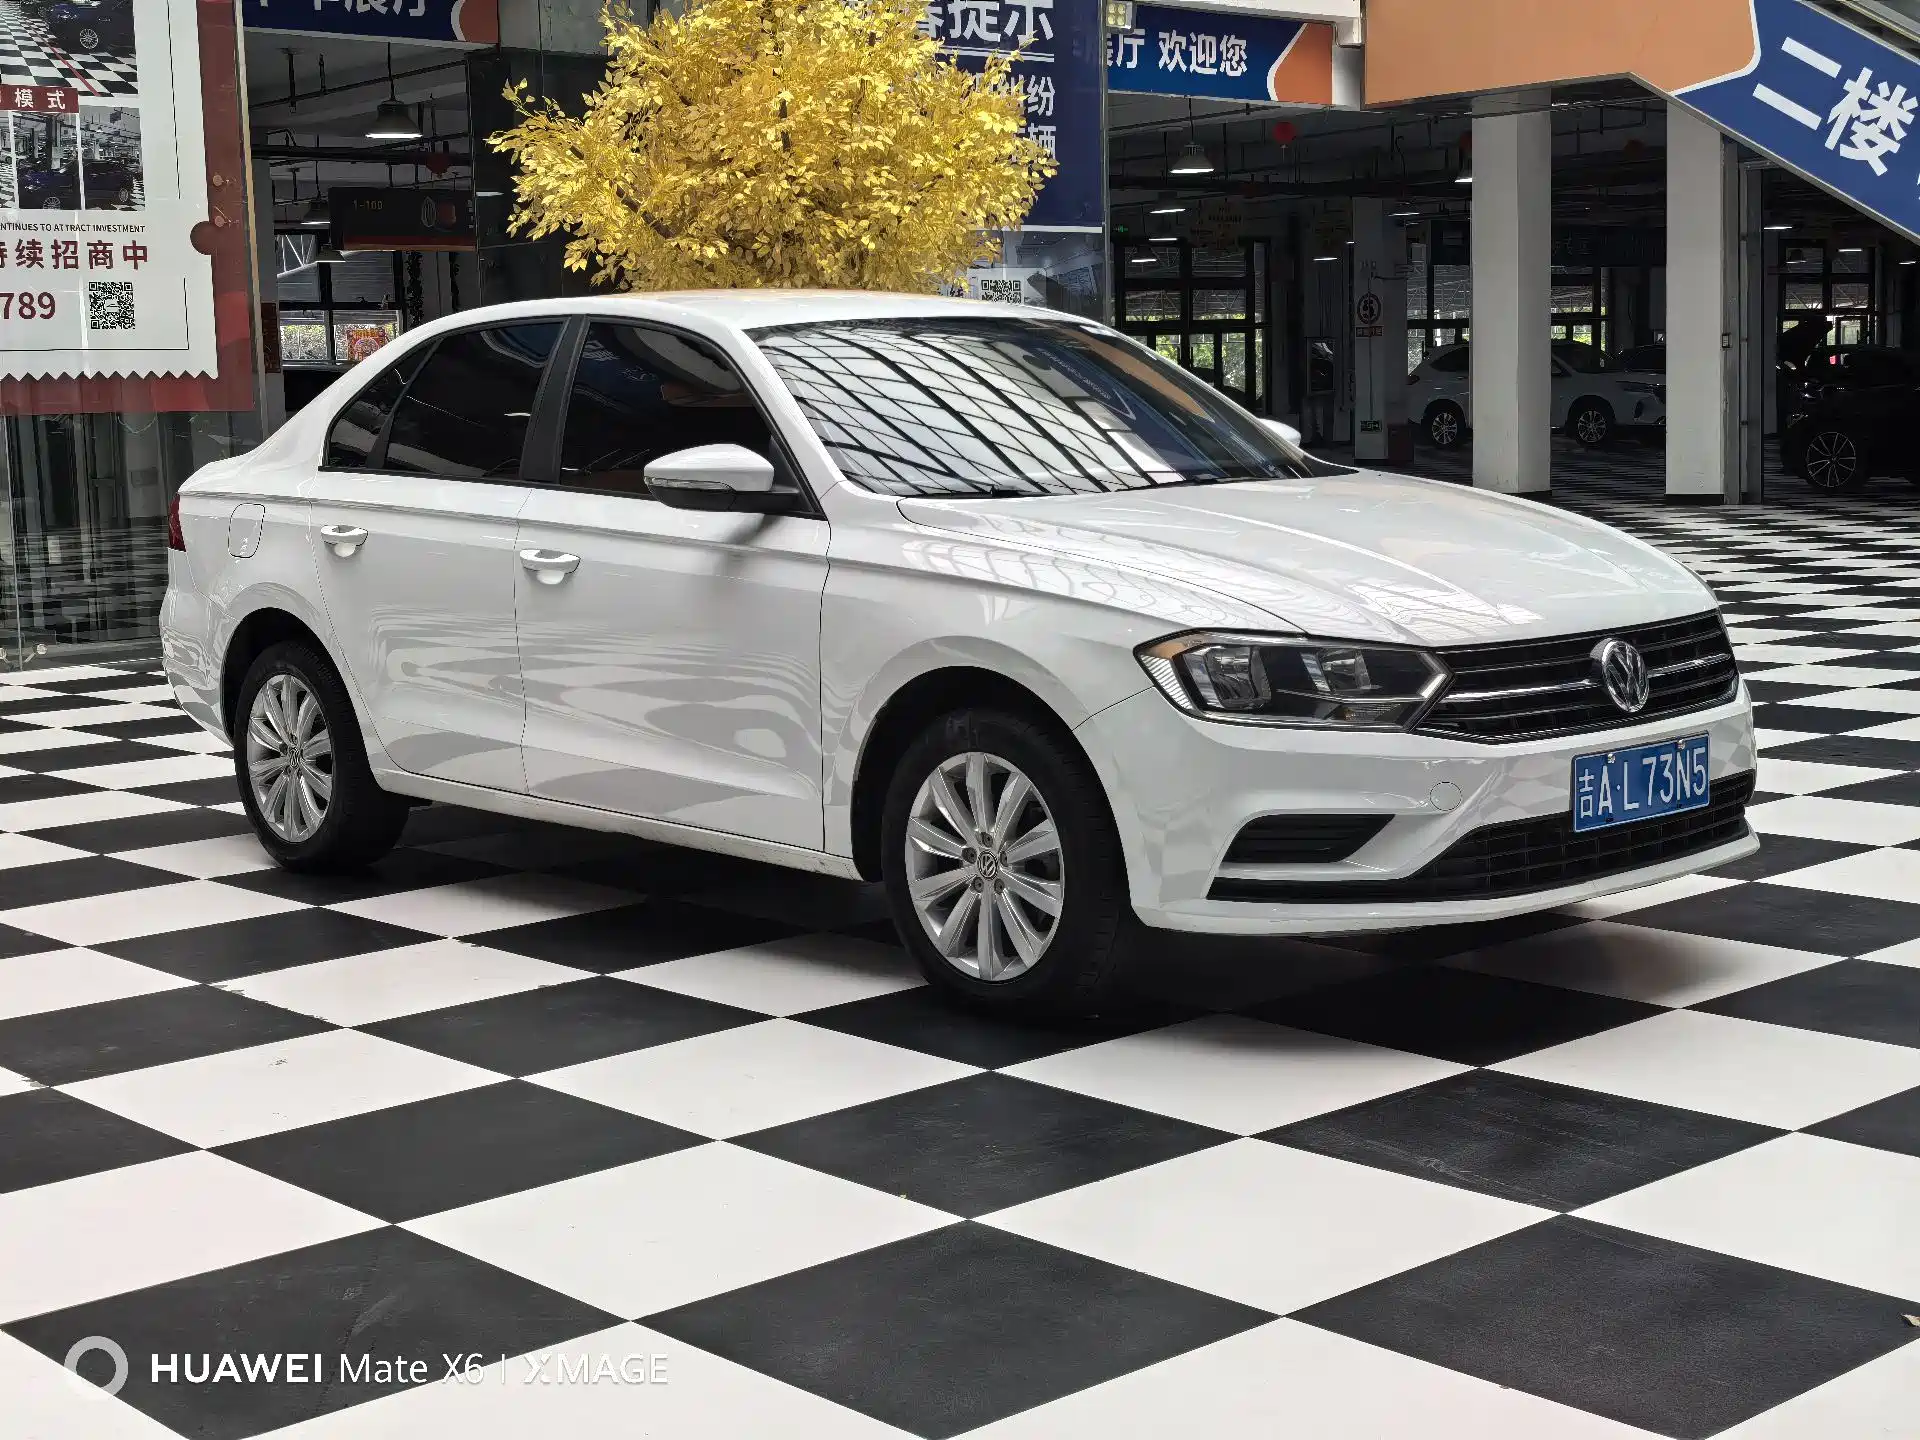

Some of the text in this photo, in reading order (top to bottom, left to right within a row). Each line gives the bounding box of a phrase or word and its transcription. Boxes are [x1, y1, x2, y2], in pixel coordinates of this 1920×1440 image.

[1158, 29, 1248, 77] 欢迎您
[14, 87, 66, 110] 模式
[1752, 36, 1919, 177] 二楼
[40, 223, 52, 232] TO
[53, 223, 91, 232] ATTRACT
[92, 224, 146, 233] INVESTMENT
[0, 291, 56, 320] 789
